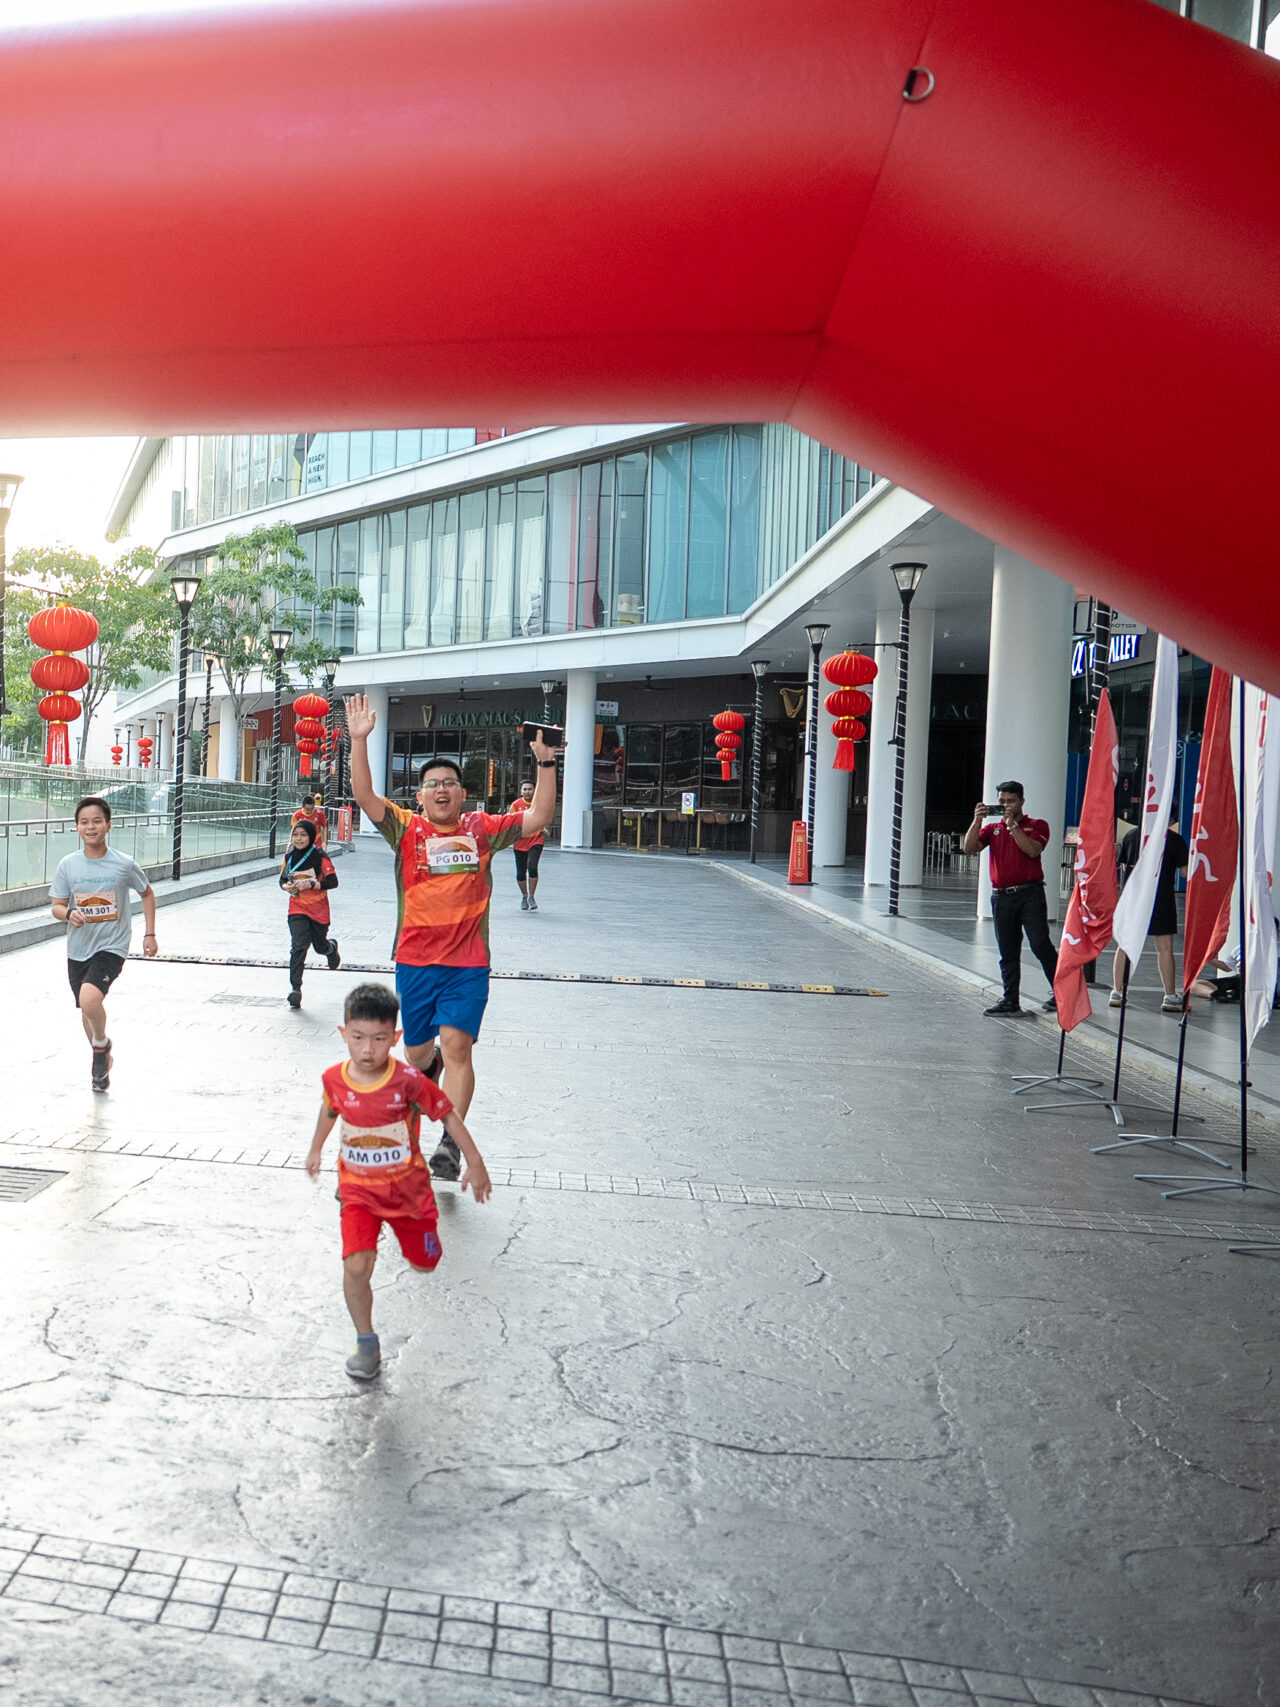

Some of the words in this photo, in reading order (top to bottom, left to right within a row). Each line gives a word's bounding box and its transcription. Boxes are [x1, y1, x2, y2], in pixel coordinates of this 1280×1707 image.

[1108, 634, 1138, 664] ALLEY
[440, 711, 479, 728] HEALY
[435, 855, 450, 864] PG
[452, 853, 472, 863] 010
[95, 906, 111, 915] 301
[347, 1150, 369, 1163] AM
[372, 1149, 401, 1163] 010
